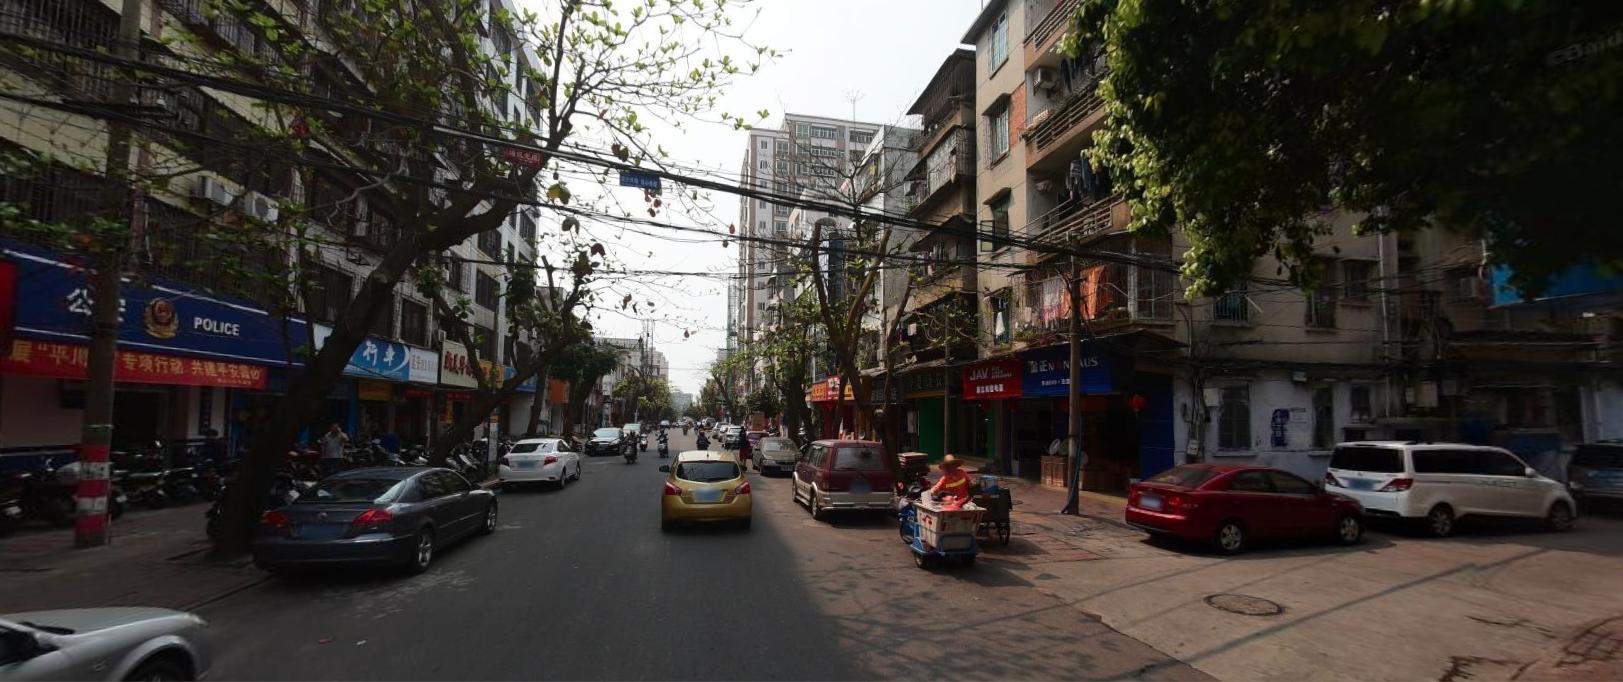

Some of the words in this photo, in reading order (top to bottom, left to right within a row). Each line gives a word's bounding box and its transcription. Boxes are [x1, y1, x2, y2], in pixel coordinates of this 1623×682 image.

[193, 316, 241, 337] POLICE
[122, 352, 185, 375] 专项行动
